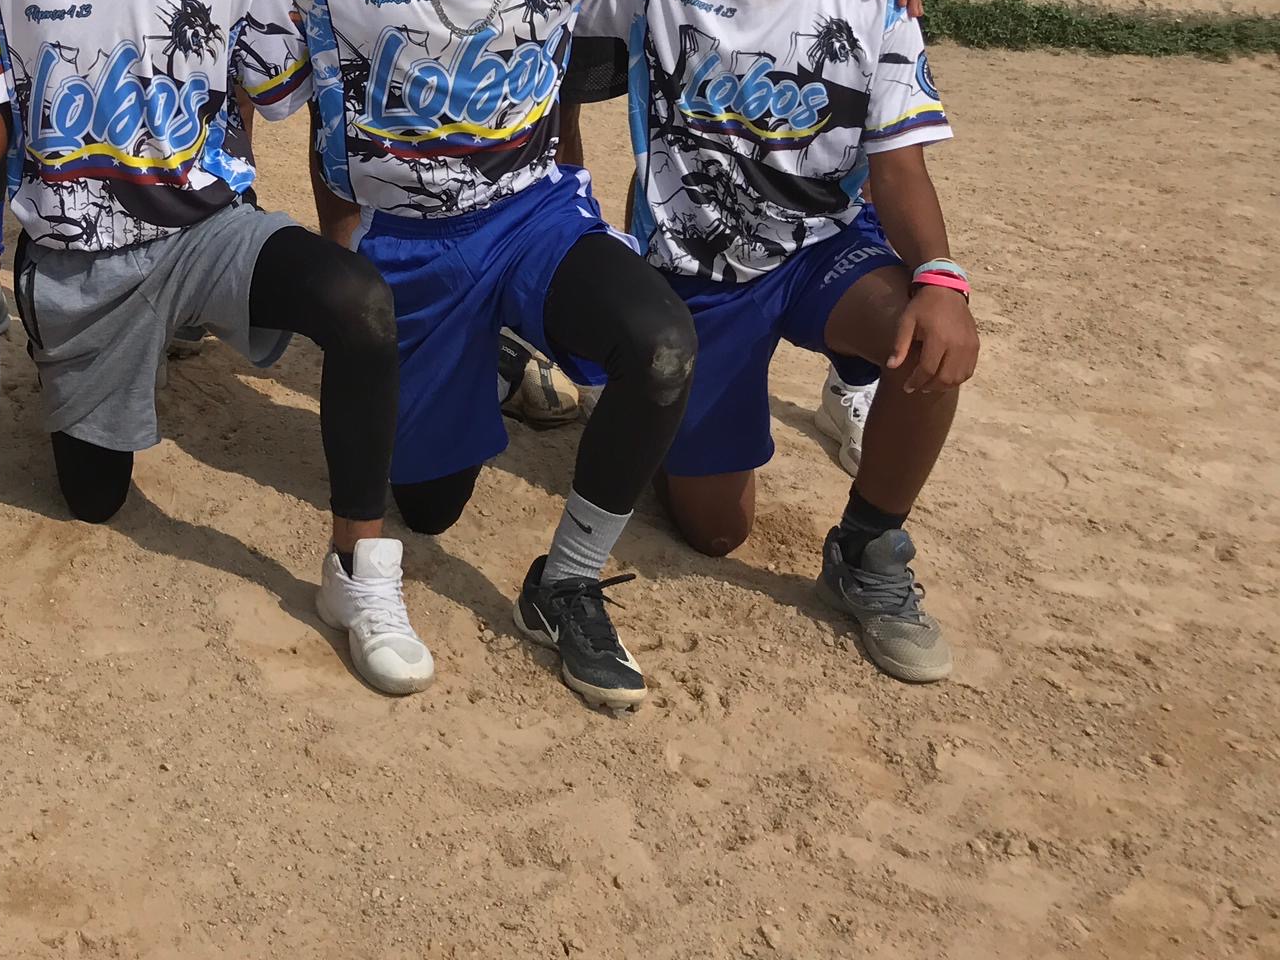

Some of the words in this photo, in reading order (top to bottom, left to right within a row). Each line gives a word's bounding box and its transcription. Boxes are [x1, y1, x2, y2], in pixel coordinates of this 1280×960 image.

[25, 39, 210, 154] Lobos
[357, 22, 564, 133] Lobos
[678, 51, 829, 130] Lobos
